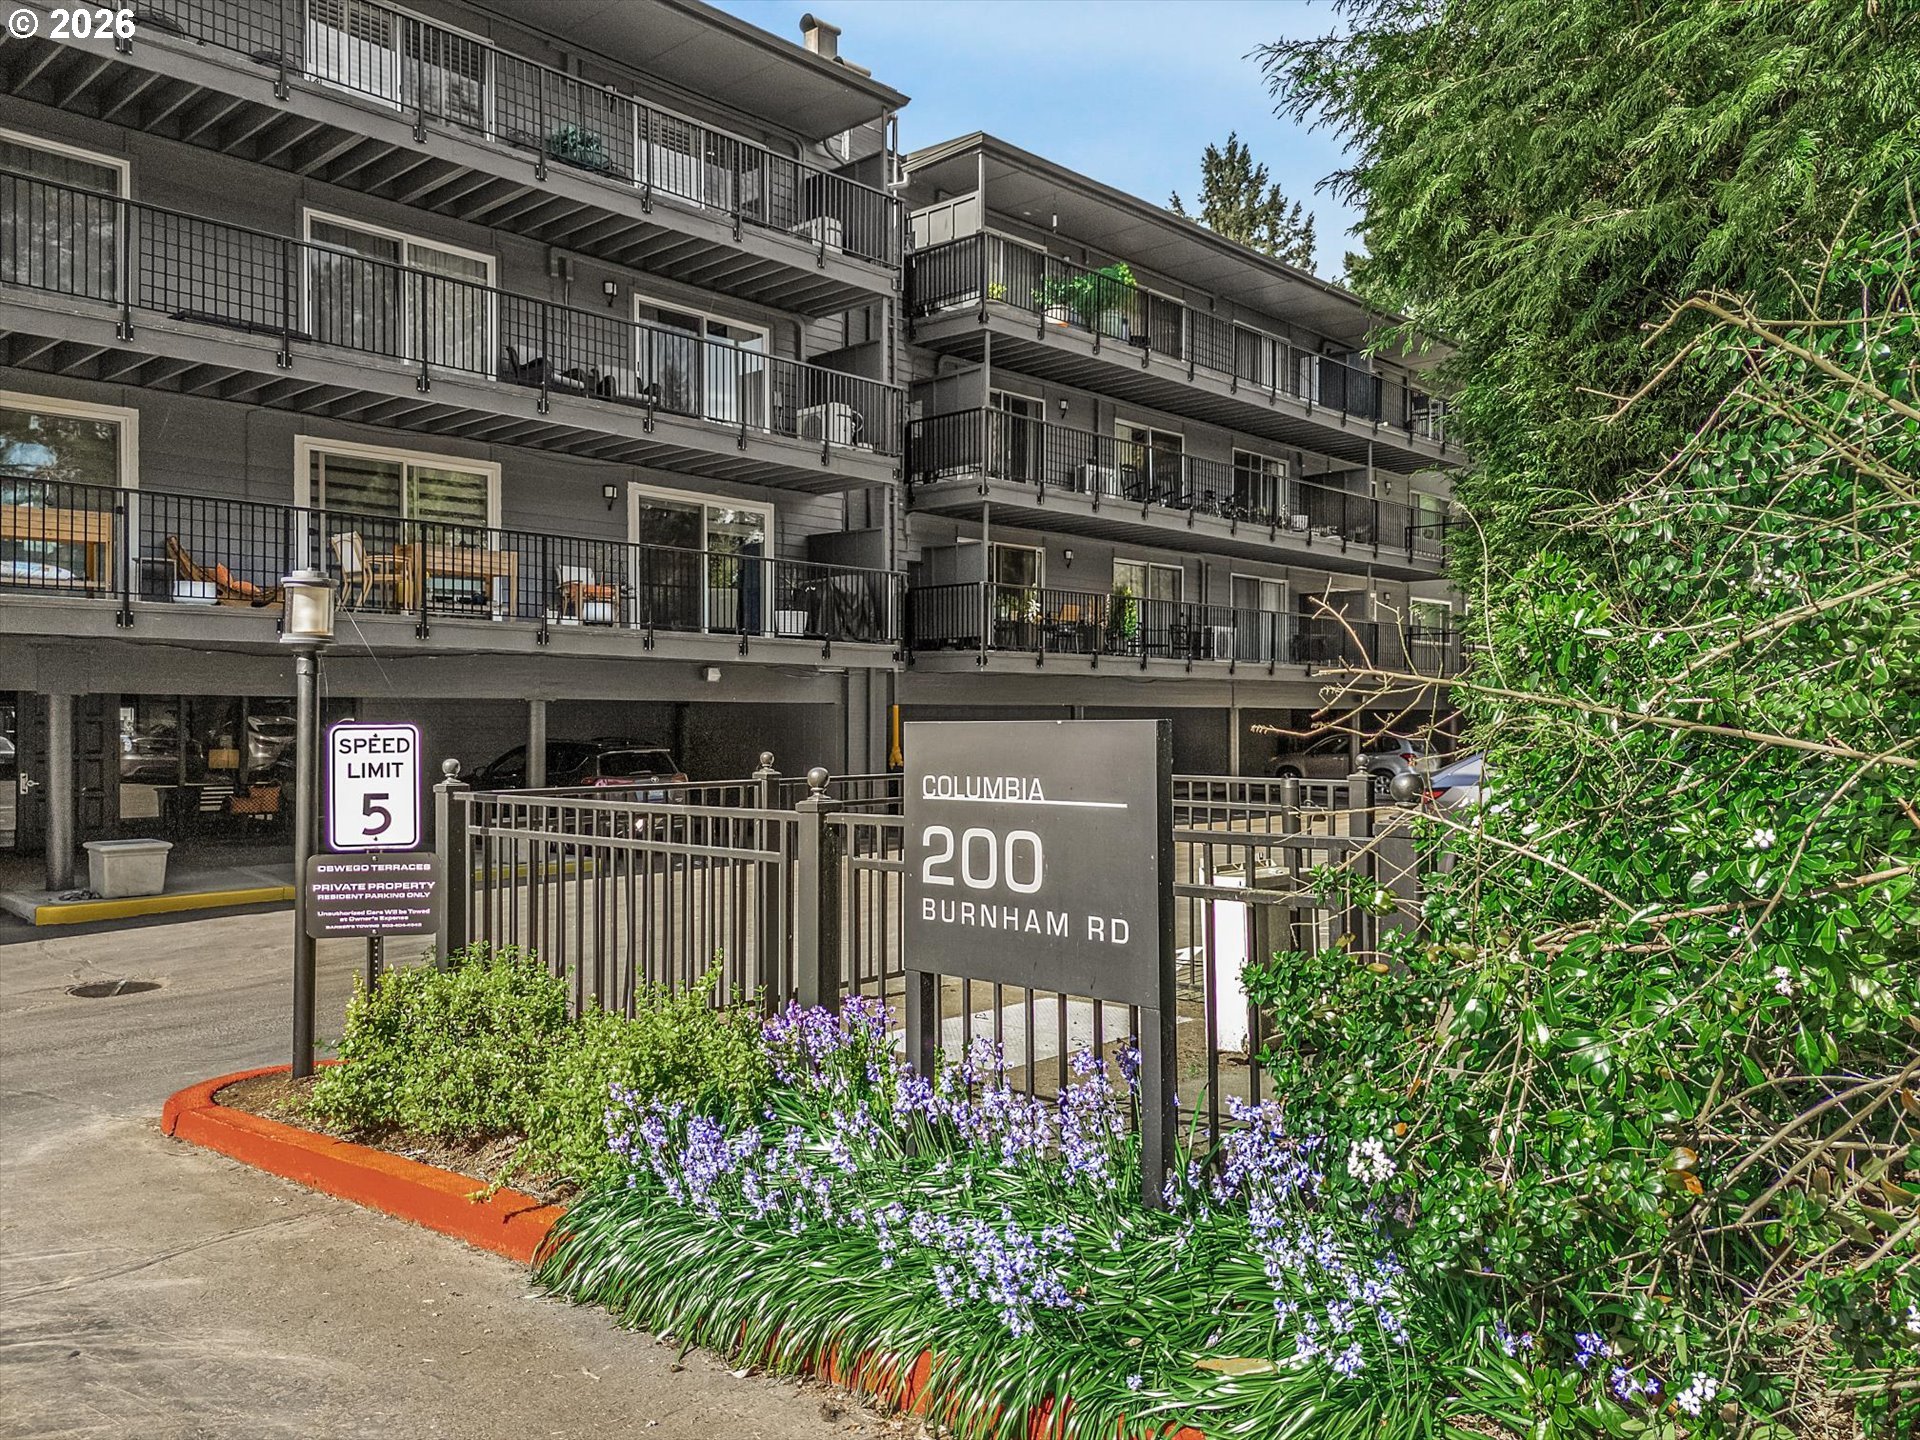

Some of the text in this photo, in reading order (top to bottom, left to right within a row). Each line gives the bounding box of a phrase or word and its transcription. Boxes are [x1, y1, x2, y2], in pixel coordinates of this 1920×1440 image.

[338, 737, 411, 754] SPEED
[347, 762, 404, 779] LIMIT
[922, 775, 1045, 801] COLUMBIA
[362, 792, 392, 836] 5
[317, 863, 432, 873] OSWEGO TERRACES
[922, 825, 1043, 894] 200
[312, 881, 436, 892] PRIVATE PROPERTY
[317, 891, 431, 901] RESIDENT PARKING ONLY
[379, 915, 409, 923] Expense
[407, 907, 431, 915] Towed
[922, 898, 1130, 945] BURNHAM RD
